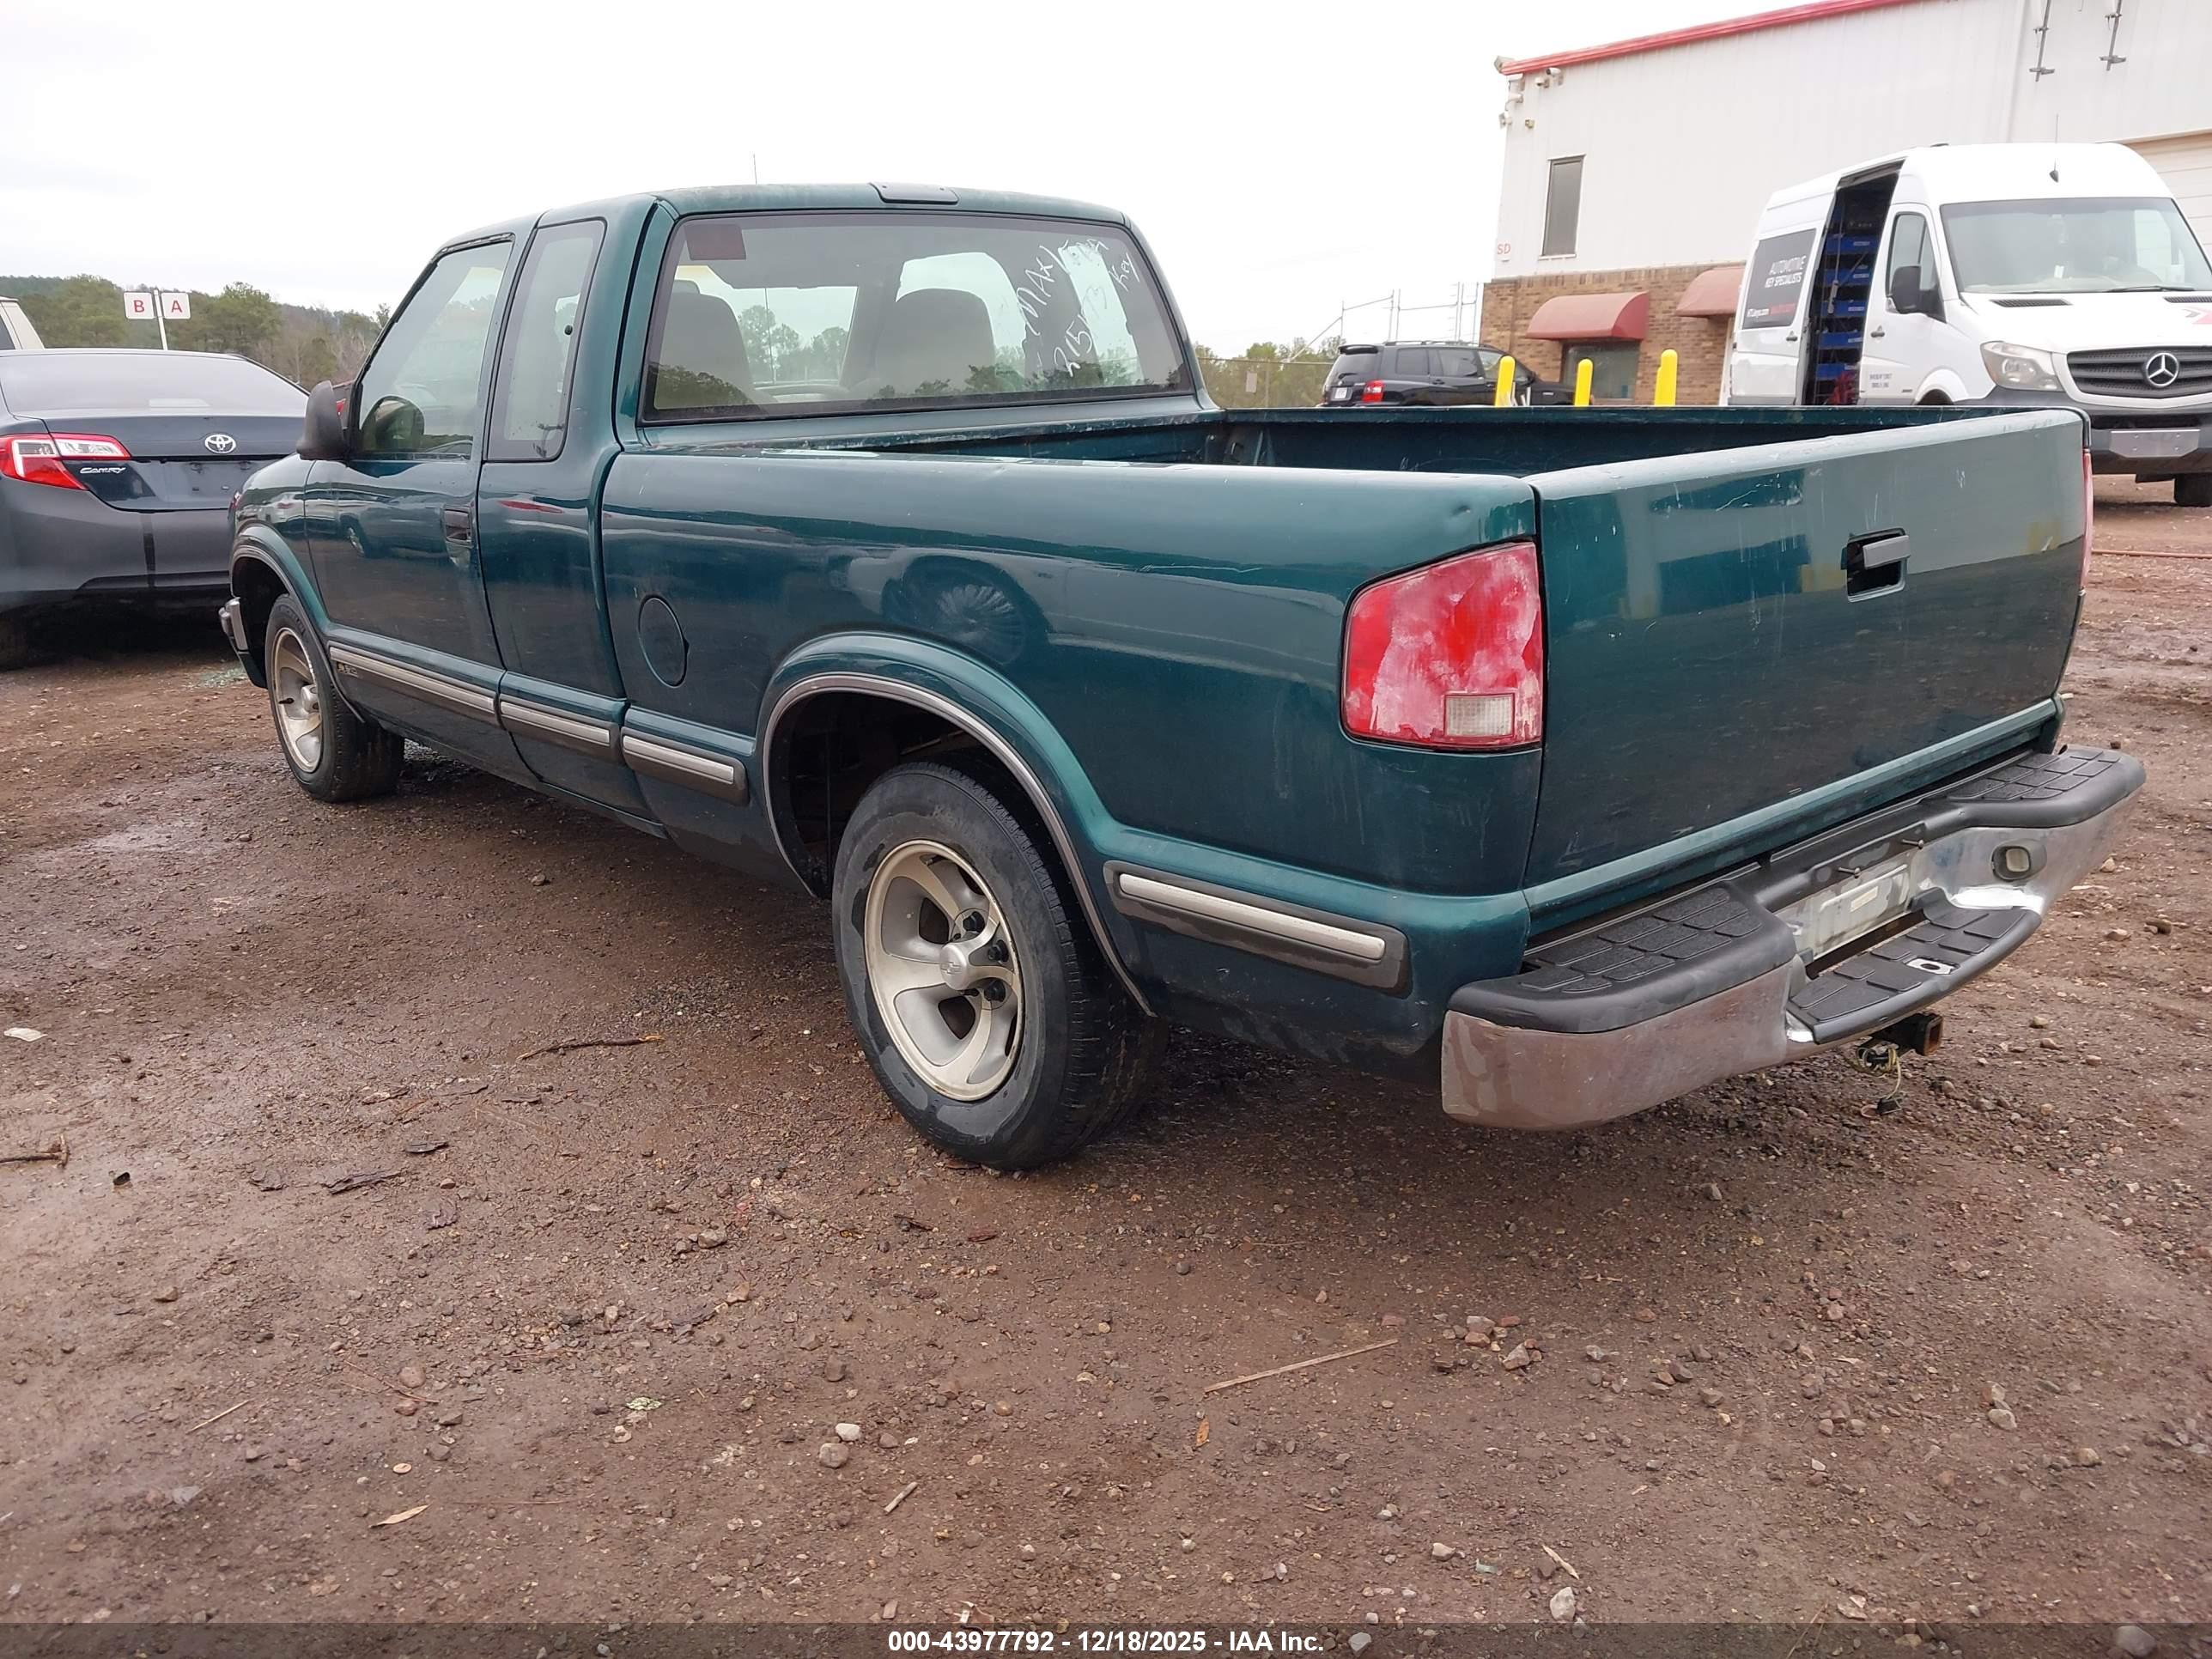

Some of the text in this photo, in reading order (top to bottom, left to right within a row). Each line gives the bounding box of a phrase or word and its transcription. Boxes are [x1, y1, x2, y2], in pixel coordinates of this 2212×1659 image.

[1497, 243, 1511, 255] SD
[1768, 255, 1807, 275] AUTOMOTIVE
[1774, 271, 1803, 287] SPECIALISTS
[133, 300, 145, 313] B
[171, 300, 183, 313] A
